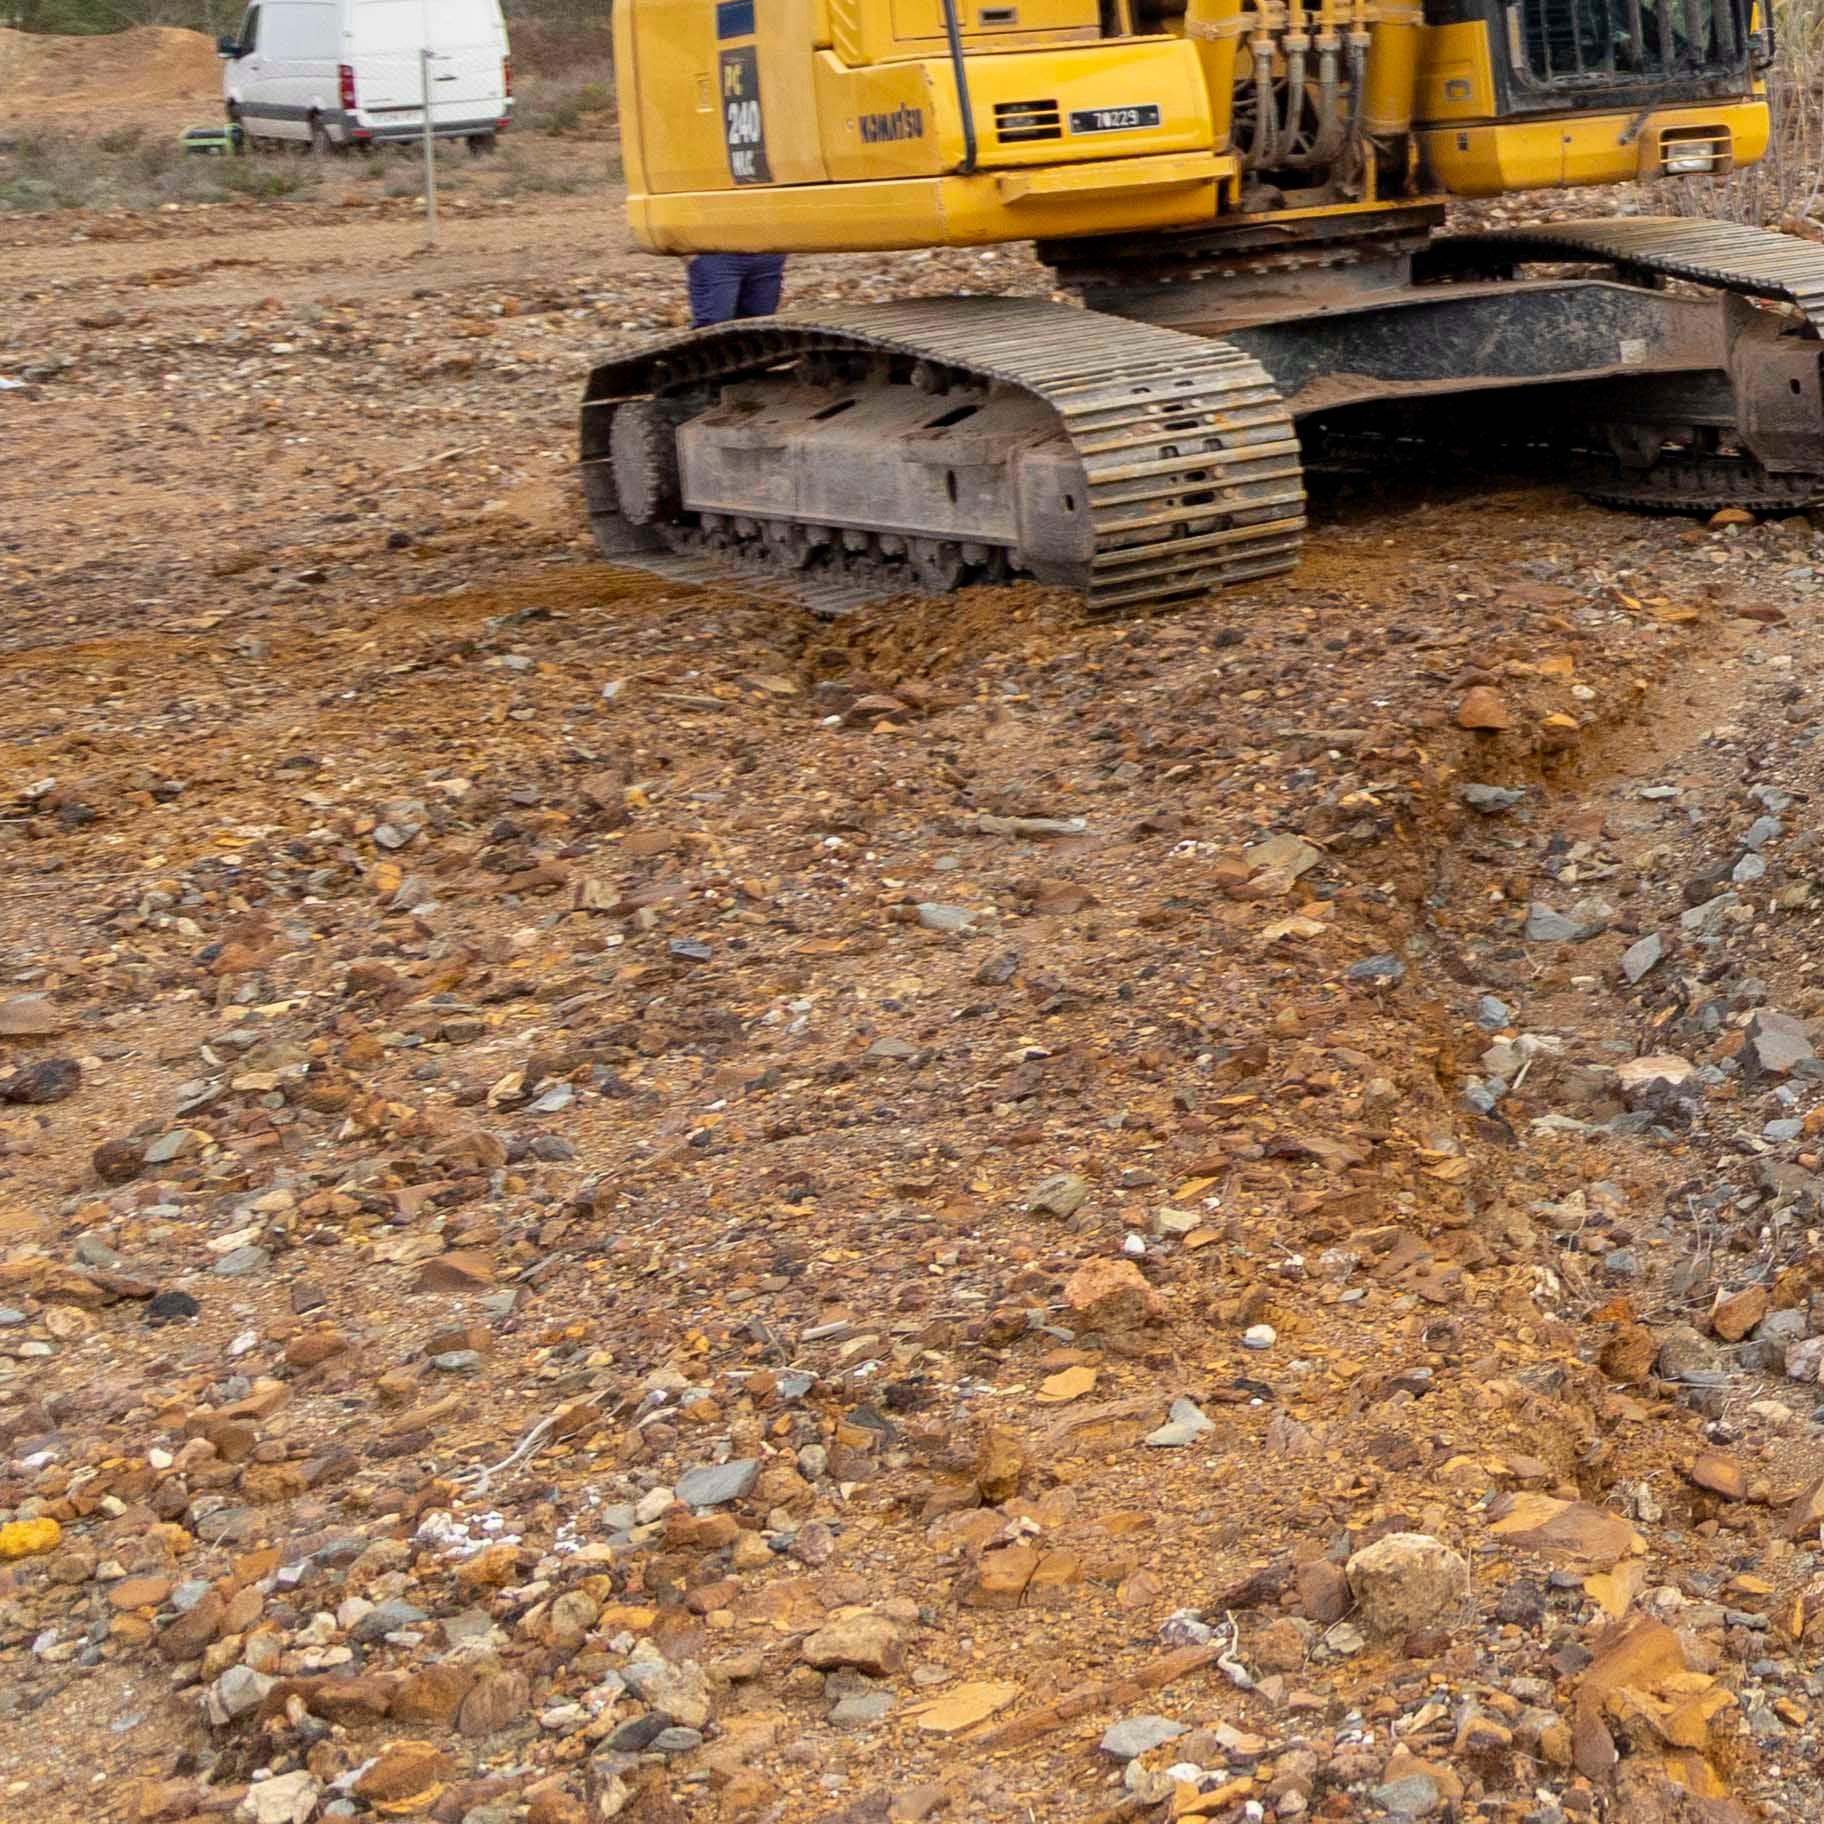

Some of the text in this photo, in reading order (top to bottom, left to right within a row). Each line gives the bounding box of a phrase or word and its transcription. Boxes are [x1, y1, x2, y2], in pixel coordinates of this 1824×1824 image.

[723, 64, 743, 96] PC
[727, 100, 761, 144] 240
[859, 102, 924, 143] KOMATSU
